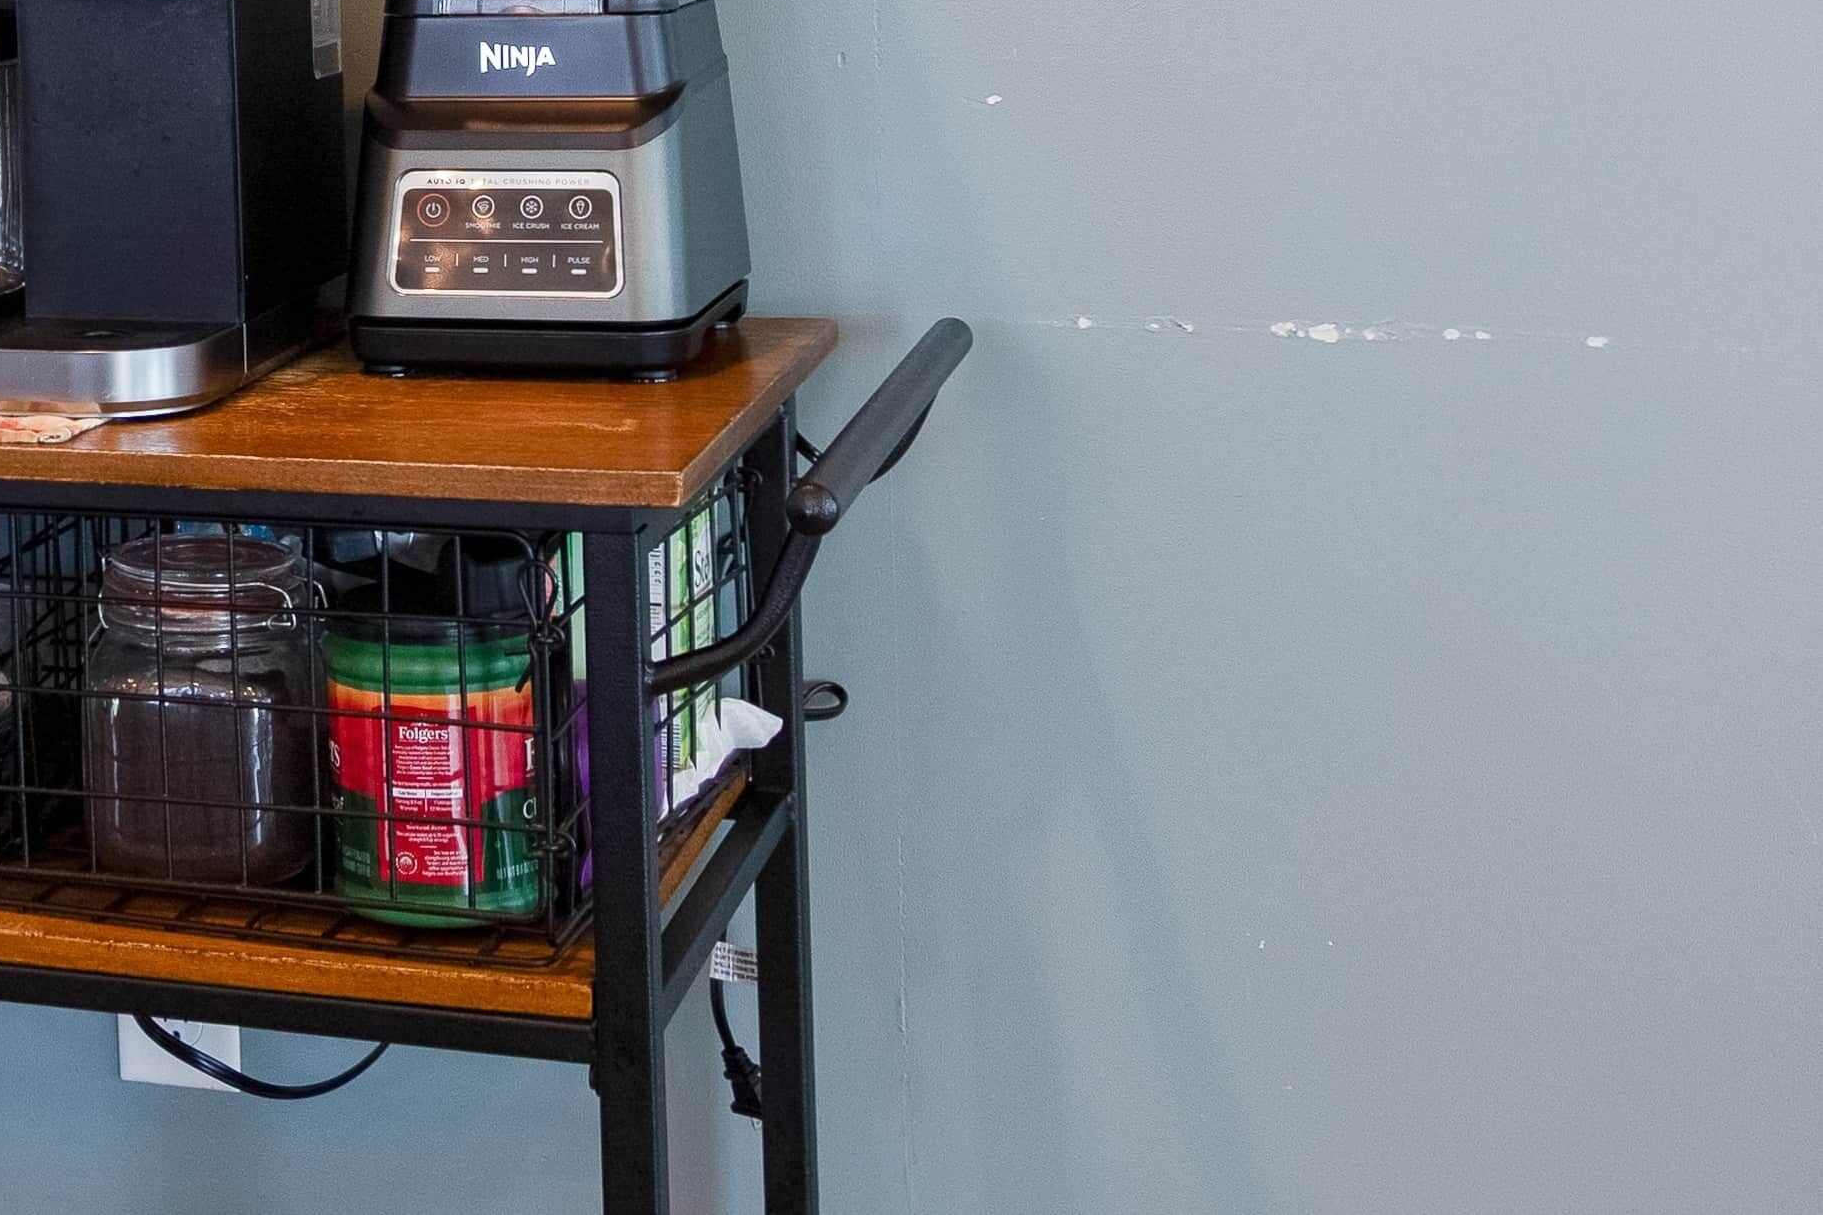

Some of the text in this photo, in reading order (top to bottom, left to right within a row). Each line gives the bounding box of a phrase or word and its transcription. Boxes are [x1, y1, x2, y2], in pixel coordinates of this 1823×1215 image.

[480, 41, 556, 77] NINJA
[503, 178, 553, 186] CRUSHING
[512, 222, 550, 230] ICE CRUSH
[561, 222, 600, 231] ICE CREAM
[424, 255, 442, 263] LOW
[567, 257, 591, 265] PULSE
[398, 726, 451, 744] Folgers
